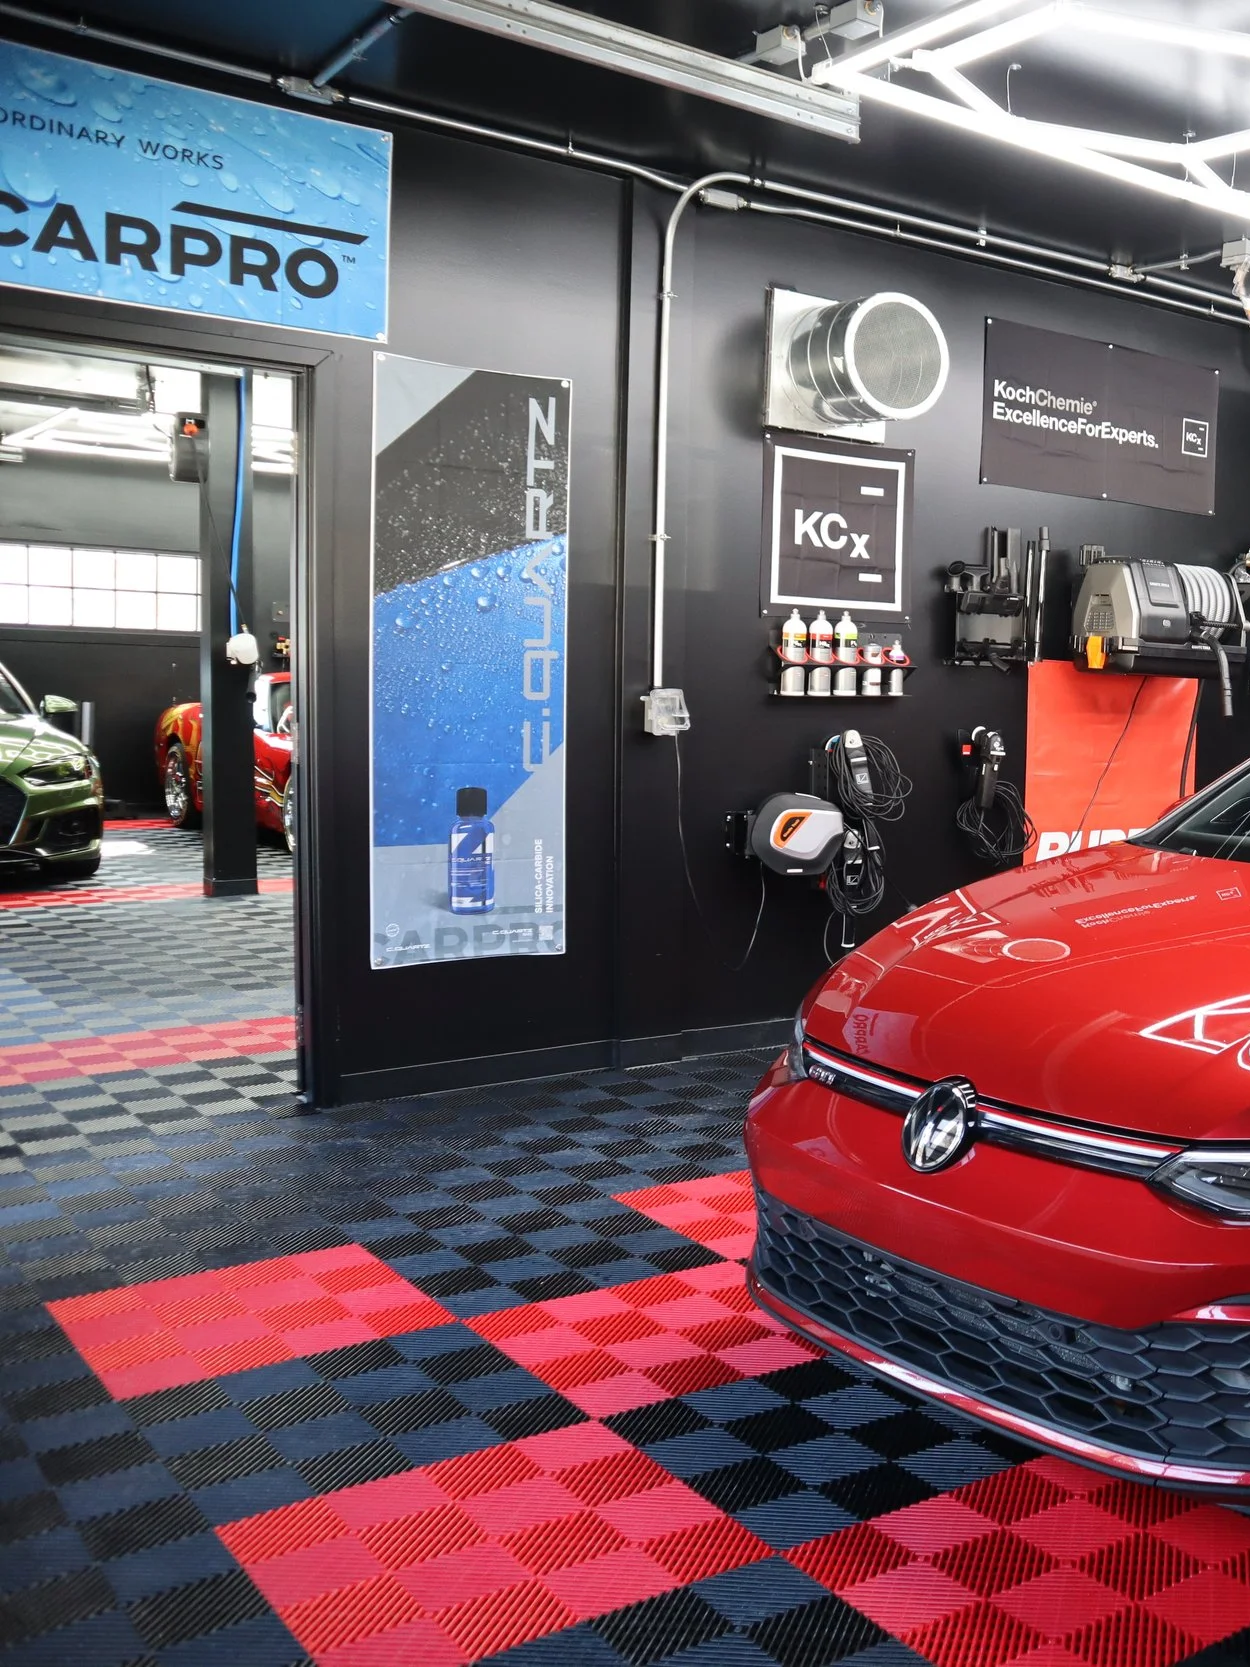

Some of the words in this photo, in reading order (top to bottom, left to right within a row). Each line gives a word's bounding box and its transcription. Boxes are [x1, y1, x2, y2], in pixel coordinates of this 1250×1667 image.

[138, 139, 225, 171] WORKS
[992, 401, 1159, 449] ExcellenceForExperts.
[545, 855, 554, 913] INNOVATION
